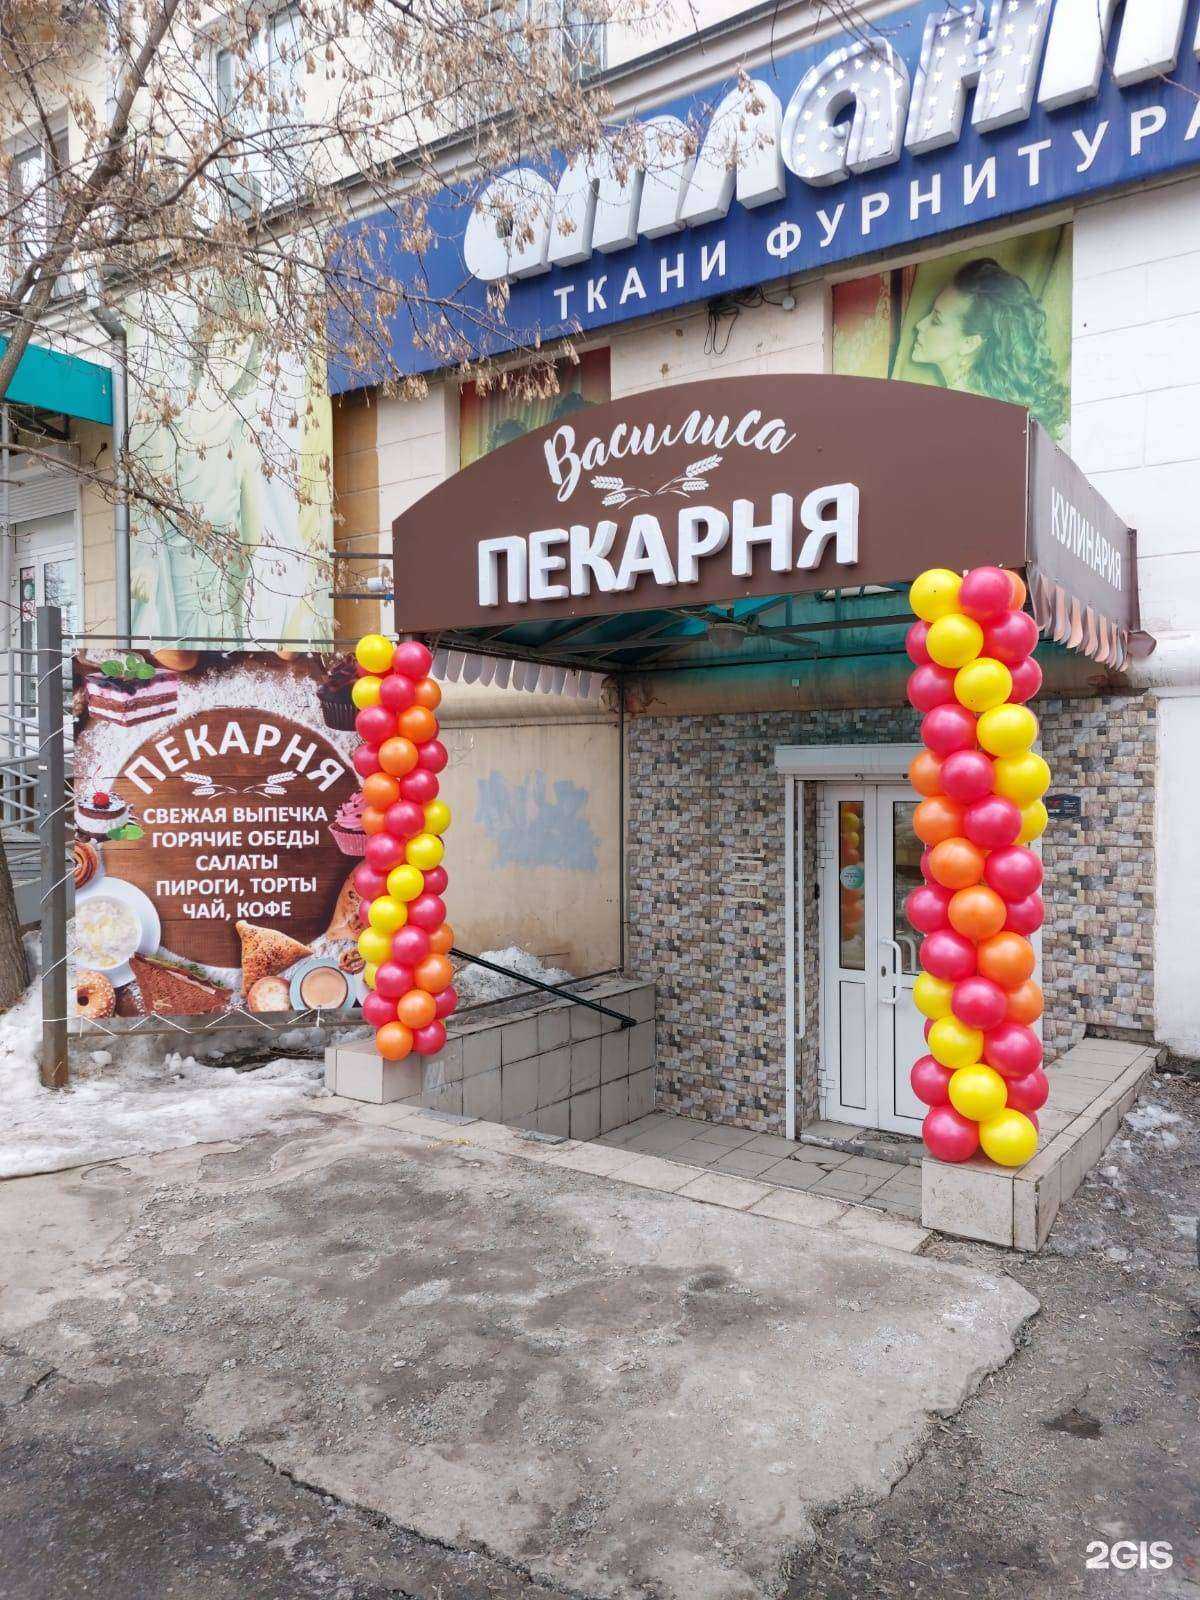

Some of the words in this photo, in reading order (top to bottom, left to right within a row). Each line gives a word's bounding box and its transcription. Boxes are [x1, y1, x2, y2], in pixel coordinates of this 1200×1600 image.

[553, 240, 726, 320] ТКАНИ
[543, 409, 797, 503] Василиса
[477, 482, 861, 607] ПЕКАРНЯ
[1050, 486, 1123, 591] КУЛИНАРИЯ
[123, 721, 346, 794] ПЕКАРНЯ
[143, 807, 226, 824] СВЕЖАЯ
[233, 806, 328, 823] ВЫПЕЧКА
[152, 831, 242, 848] ГОРЯЧИЕ
[248, 829, 320, 849] ОБЕДЫ
[195, 854, 278, 871] САЛАТЫ
[156, 878, 245, 896] ПИРОГИ,
[249, 877, 317, 893] ТОРТЫ
[182, 899, 231, 921] ЧАЙ,
[237, 900, 292, 918] КОФЕ
